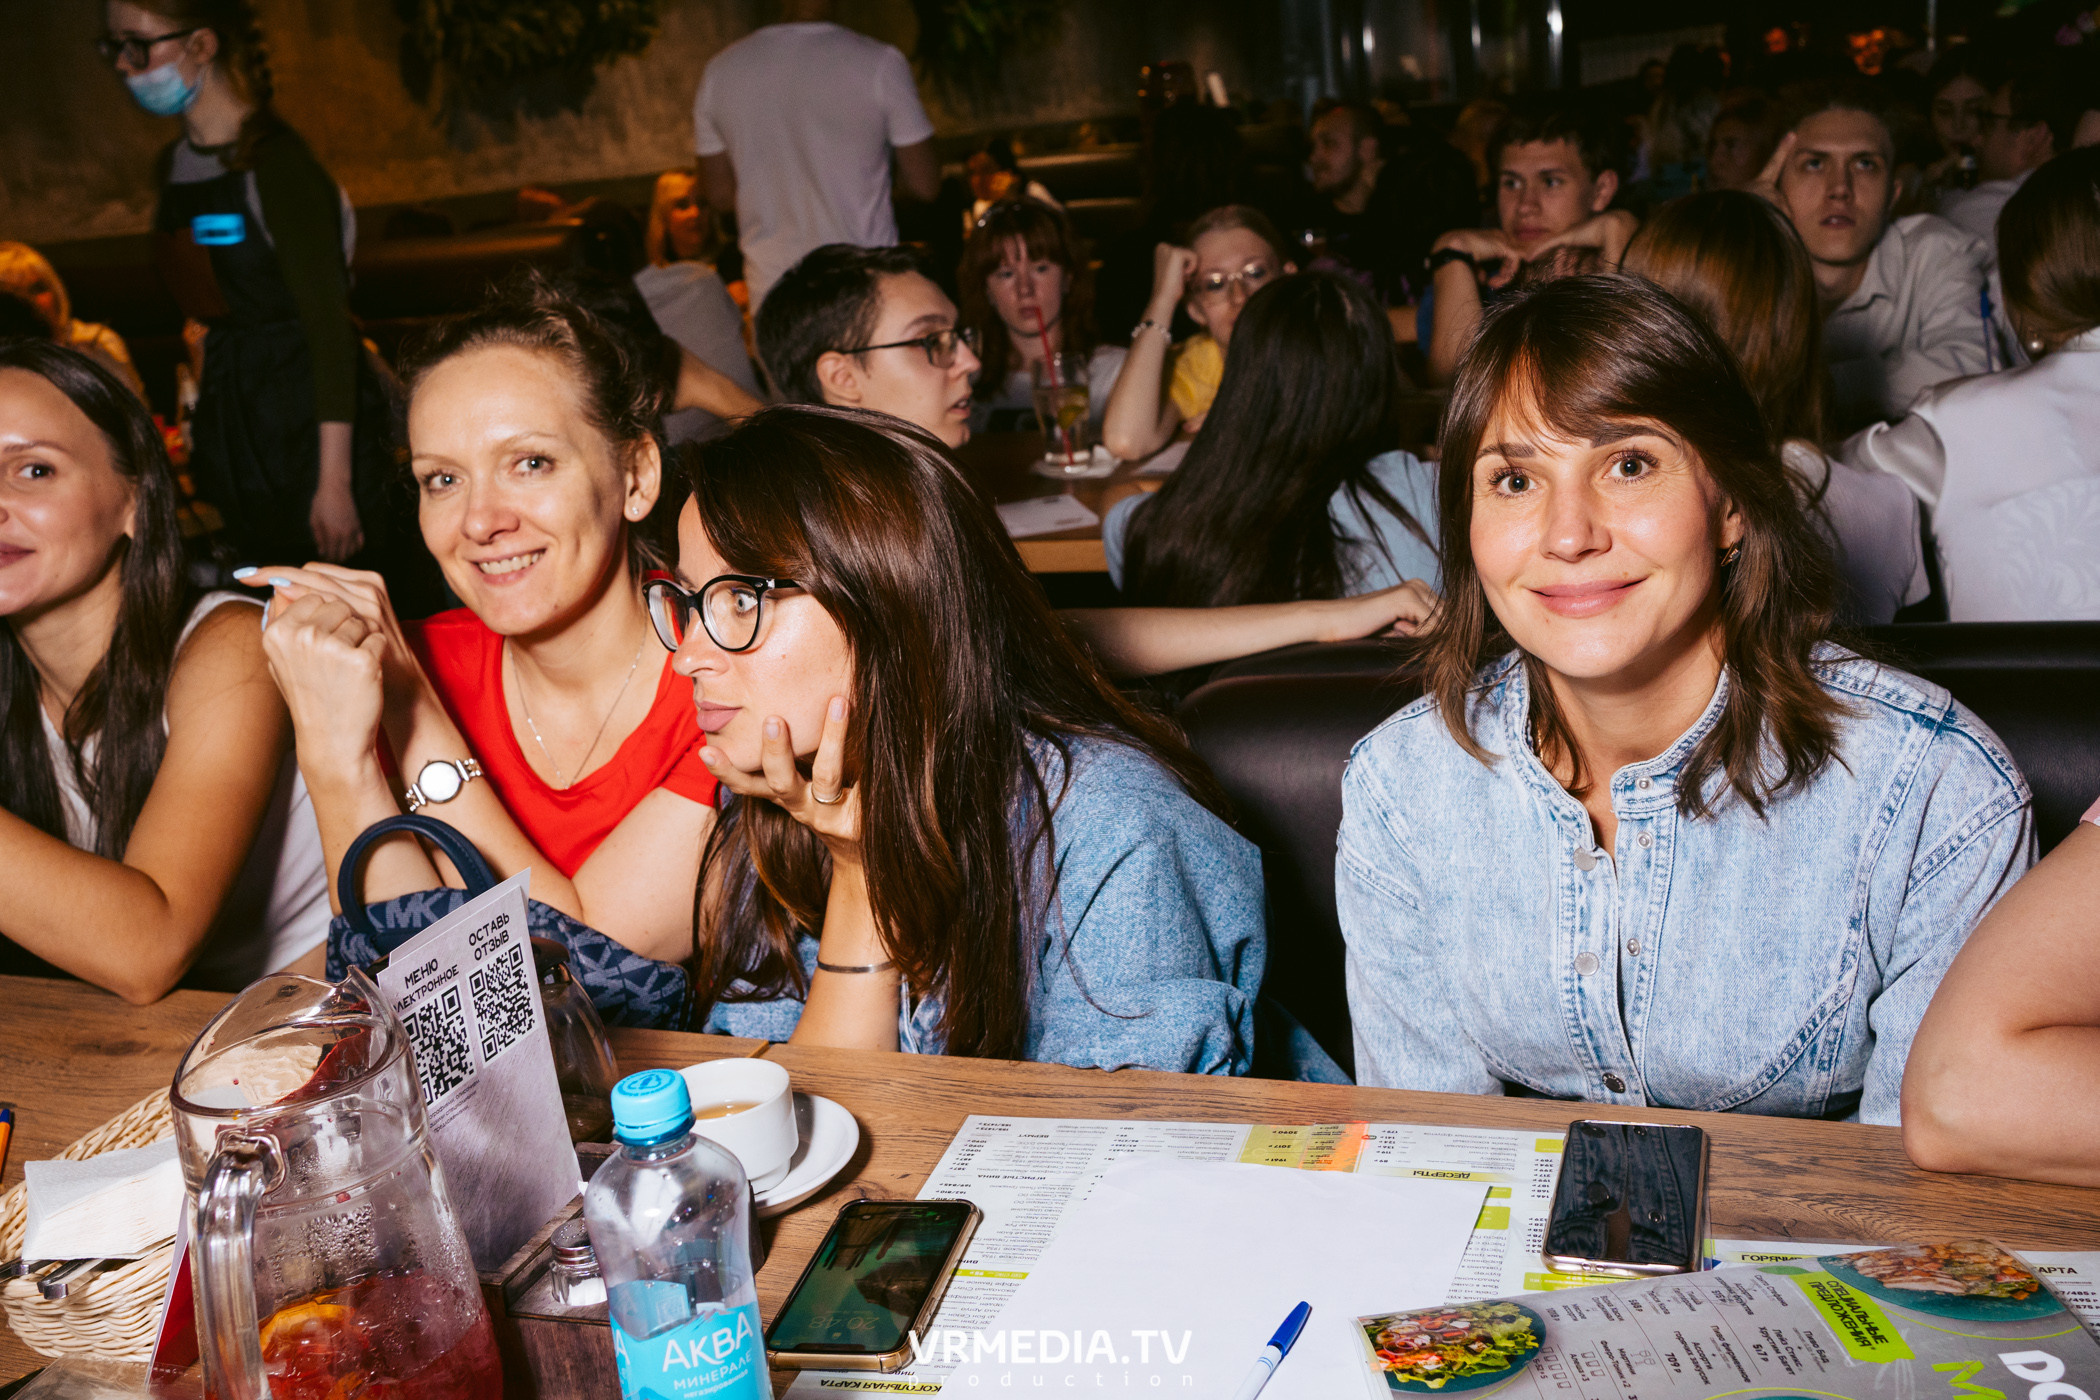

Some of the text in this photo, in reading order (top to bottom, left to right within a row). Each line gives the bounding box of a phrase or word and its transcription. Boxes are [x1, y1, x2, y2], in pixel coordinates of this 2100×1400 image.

[468, 912, 510, 946] ОСТАВЬ
[474, 930, 510, 961] ОТЗЫВ
[404, 958, 438, 989] МЕНЮ
[1413, 1170, 1471, 1180] ДЕСЕРТЫ
[2038, 1266, 2078, 1274] АРТА
[1732, 1294, 1755, 1315] фруктов
[1766, 1285, 1788, 1307] Стефано
[1827, 1281, 1889, 1345] СПЕЦИАЛЬНЫЕ
[662, 1311, 755, 1373] АКВА
[1692, 1342, 1713, 1370] Ассорти
[1710, 1325, 1725, 1342] Пиво
[1722, 1342, 1751, 1383] фирменное
[1753, 1344, 1768, 1357] 517
[1758, 1326, 1796, 1375] Хрустим Багет
[1773, 1329, 1803, 1368] Лейз Стикс
[1804, 1330, 1820, 1349] Пиво
[1816, 1349, 1830, 1364] Бад
[674, 1346, 754, 1391] МИНЕРАЛЕ
[1570, 1353, 1584, 1374] Алеша
[1617, 1348, 1636, 1375] Мартини
[1664, 1352, 1681, 1368] 709
[1673, 1330, 1711, 1386] горячих закусок
[820, 1379, 861, 1389] КАРТА
